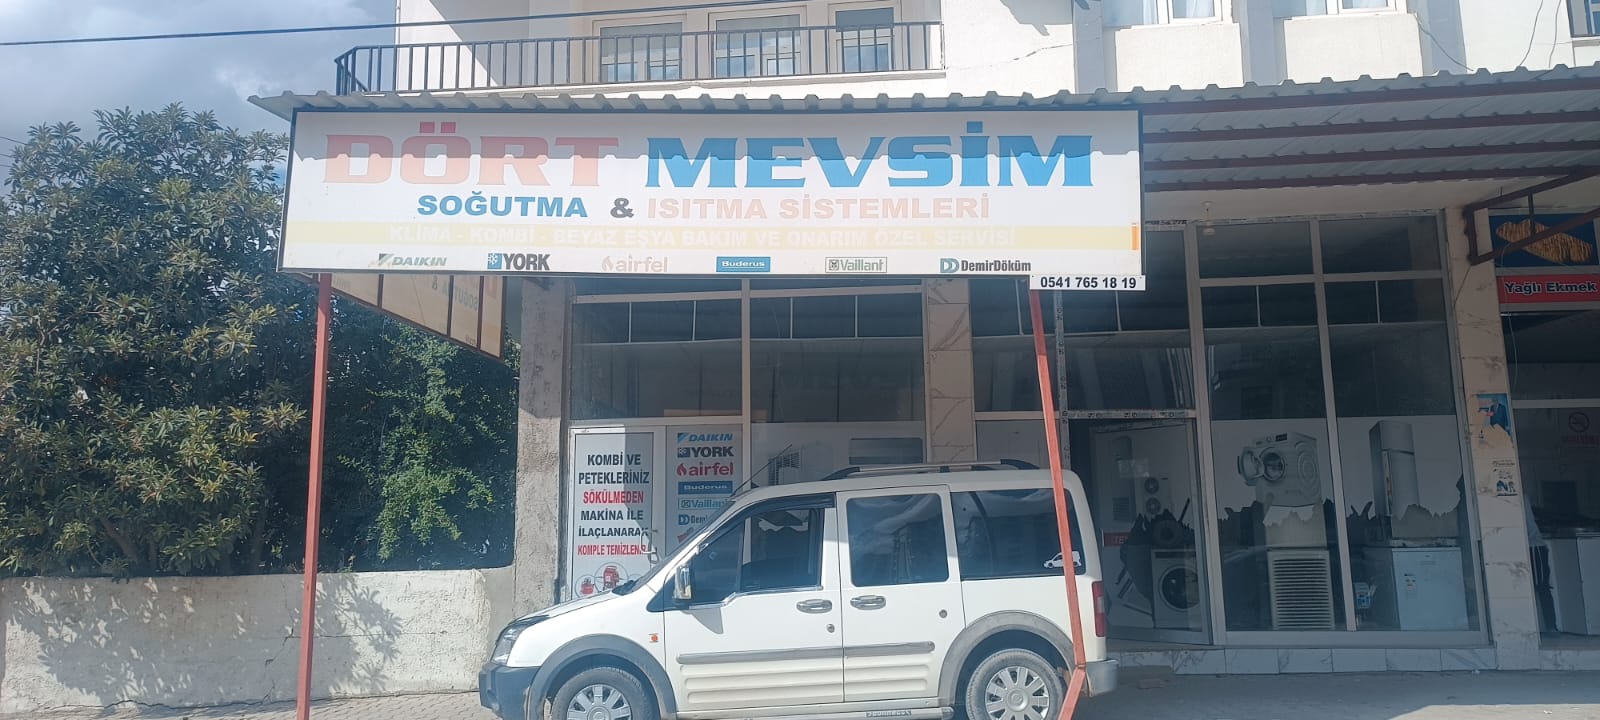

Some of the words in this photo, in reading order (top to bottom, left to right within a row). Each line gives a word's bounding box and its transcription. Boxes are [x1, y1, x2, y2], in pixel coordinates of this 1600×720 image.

[324, 121, 619, 187] DÖRT
[645, 120, 1094, 188] MEVSİM
[417, 190, 588, 218] SOĞUTMA
[610, 198, 634, 219] &
[648, 198, 768, 219] ISITMA
[779, 192, 990, 219] SİSTEMLERİ
[389, 224, 450, 242] KLİMA
[471, 224, 535, 243] KOMBİ
[554, 227, 616, 245] BEYAZ
[624, 229, 677, 248] EŞYA
[683, 229, 747, 246] BAKIM
[755, 230, 780, 246] VE
[786, 230, 867, 247] ONARIM
[875, 226, 928, 247] ÖZEL
[934, 225, 1016, 246] SERVİSİ
[391, 256, 447, 267] DAIKIN
[503, 253, 551, 271] YORK
[615, 256, 668, 273] airfel
[721, 259, 766, 269] Buderus
[840, 258, 885, 272] Vaillant
[961, 258, 1032, 273] DemirDöküm
[1040, 276, 1071, 290] 0541
[1074, 276, 1099, 290] 765
[1102, 276, 1118, 290] 18
[1121, 275, 1137, 290] 19
[1504, 281, 1541, 295] Yağlı
[1546, 280, 1597, 294] Ekmek
[688, 433, 733, 442] DAIKIN
[587, 451, 623, 466] KOMBİ
[626, 453, 641, 466] VE
[691, 446, 734, 458] YORK
[688, 461, 734, 476] airfel
[578, 469, 650, 485] PETEKLERİNİZ
[583, 489, 644, 504] SÖKÜLMEDEN
[580, 507, 624, 521] MAKİNA
[626, 507, 643, 521] İLE
[577, 544, 605, 556] KOMPLE
